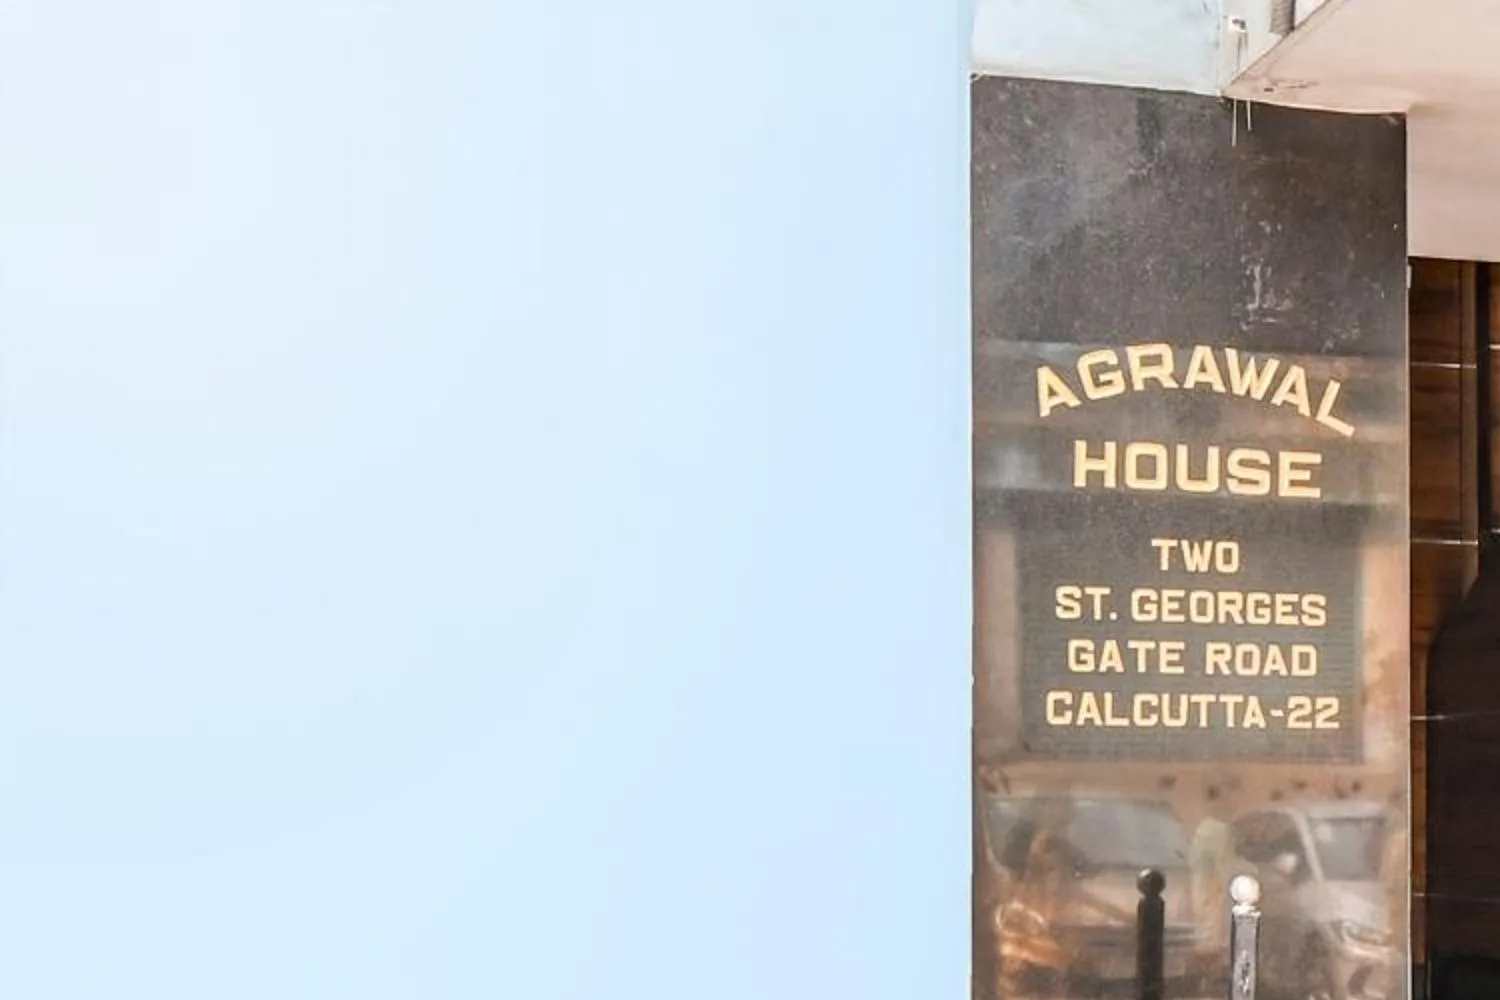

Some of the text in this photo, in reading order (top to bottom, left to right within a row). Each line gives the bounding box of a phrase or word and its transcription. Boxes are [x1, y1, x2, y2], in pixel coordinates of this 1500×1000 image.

[1036, 343, 1355, 437] AGRAWAL
[1073, 440, 1322, 498] HOUSE
[1151, 538, 1240, 573] TWO
[1055, 585, 1327, 626] ST. GEORGES
[1067, 639, 1318, 677] GATE ROAD
[1045, 690, 1340, 729] CALCUTTA-22
